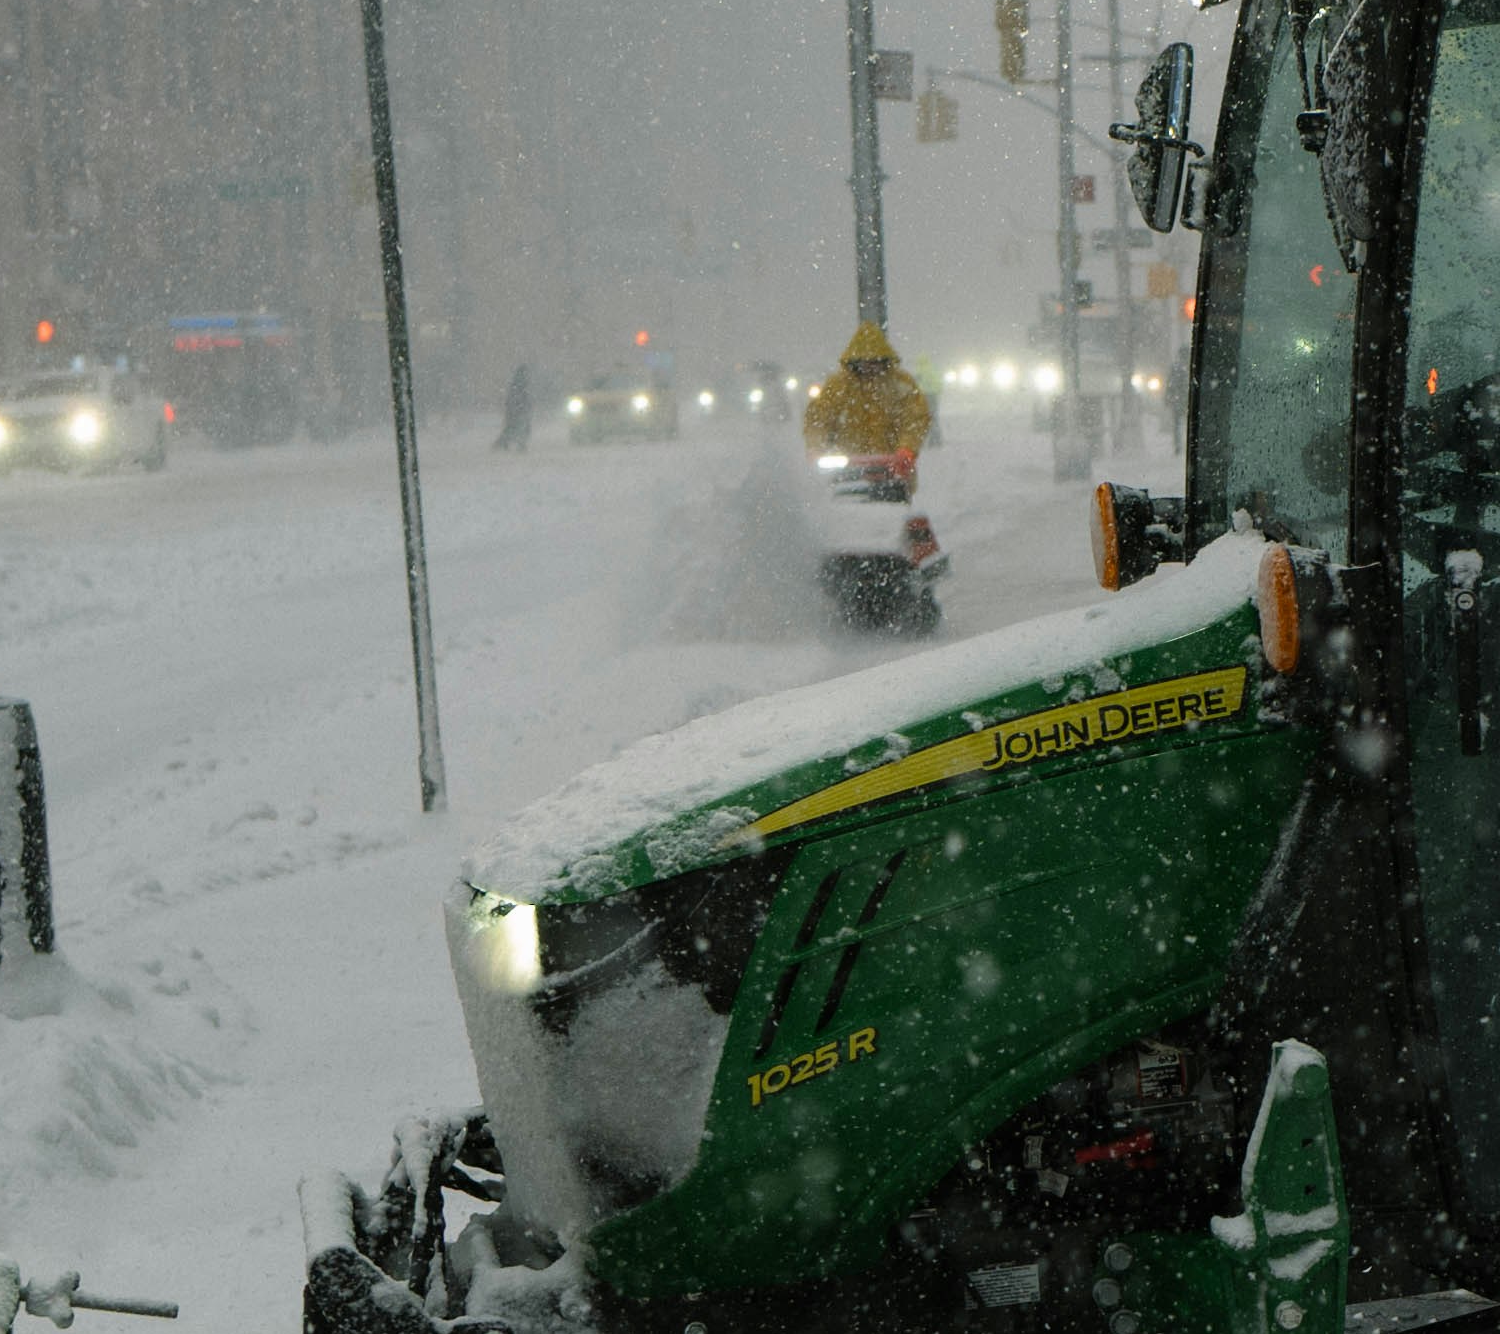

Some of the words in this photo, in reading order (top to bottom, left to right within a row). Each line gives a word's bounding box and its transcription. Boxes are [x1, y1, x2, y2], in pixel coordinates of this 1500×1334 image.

[982, 716, 1090, 767] JOHN
[1098, 688, 1228, 738] DEERE
[748, 1041, 840, 1107] 1025
[849, 1027, 877, 1062] R
